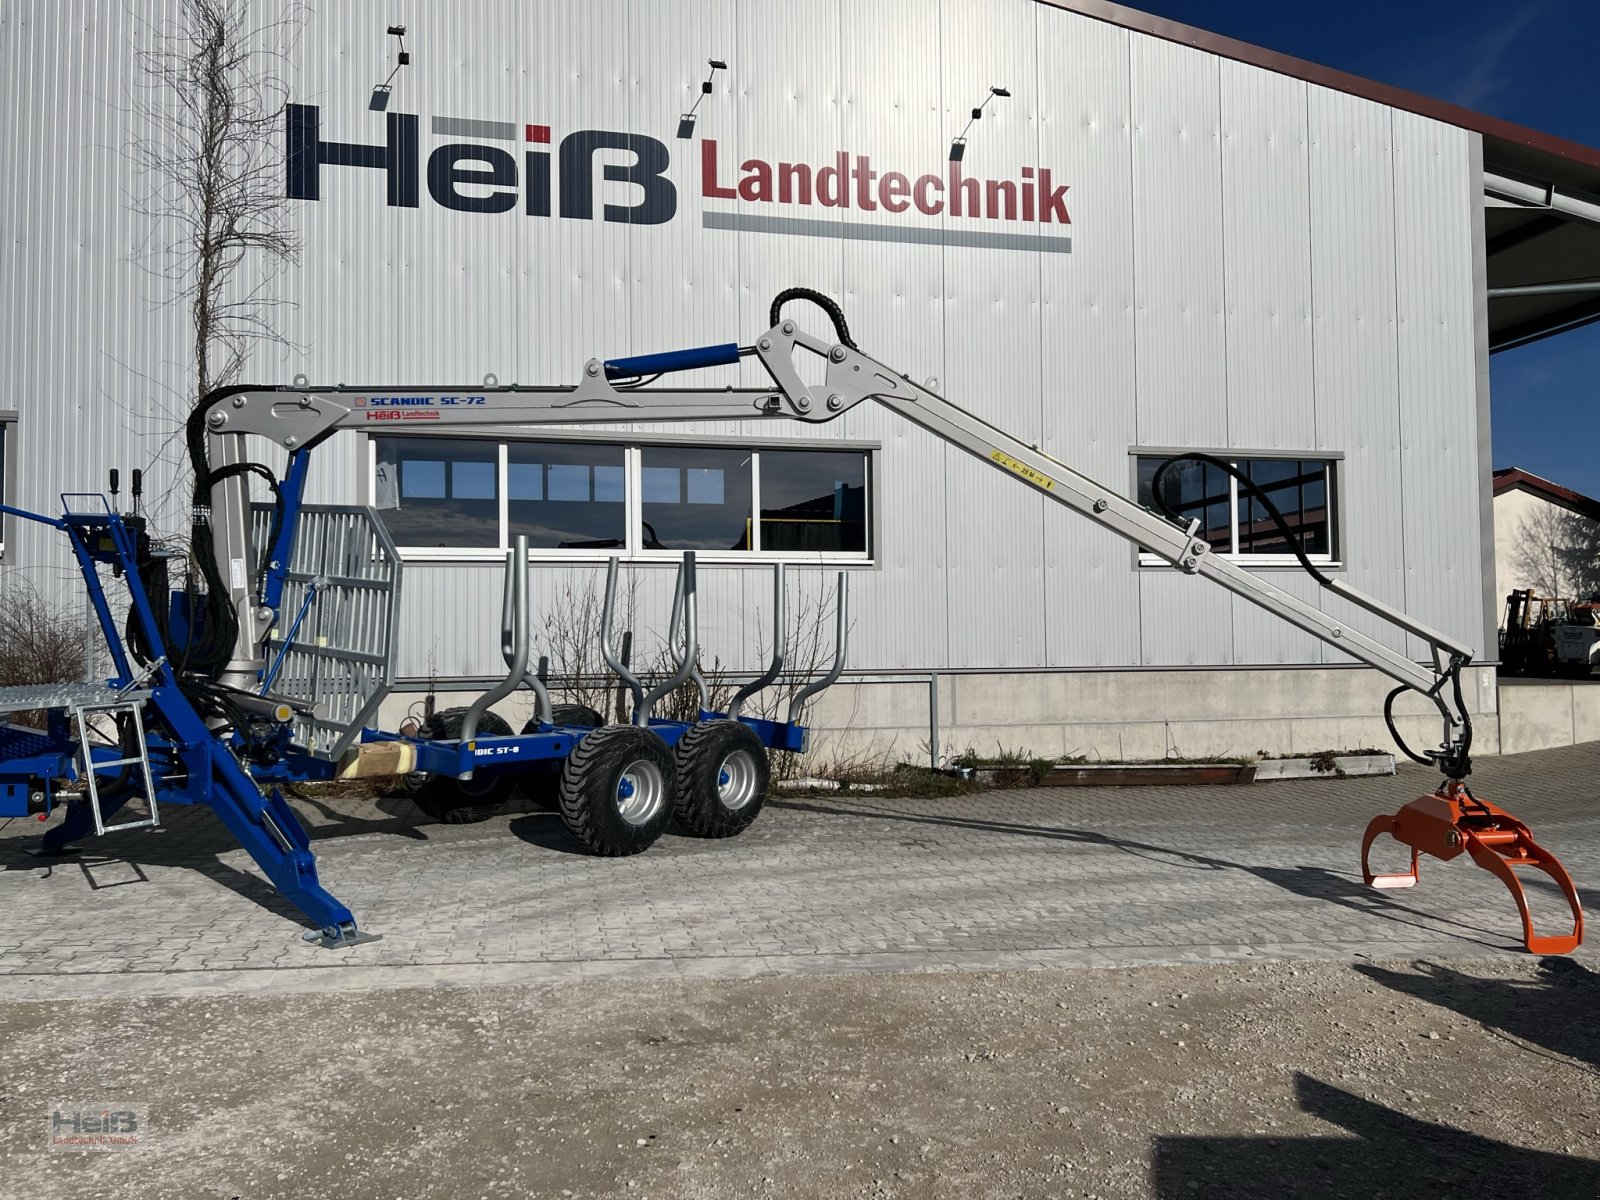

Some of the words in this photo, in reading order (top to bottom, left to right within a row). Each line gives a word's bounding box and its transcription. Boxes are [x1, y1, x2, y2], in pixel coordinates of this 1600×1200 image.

[286, 103, 677, 226] Heiß
[701, 138, 1072, 225] Landtechnik
[370, 397, 435, 406] SCANDIC
[440, 396, 486, 405] SC-72
[366, 410, 401, 420] Heiß
[1020, 467, 1029, 475] 25
